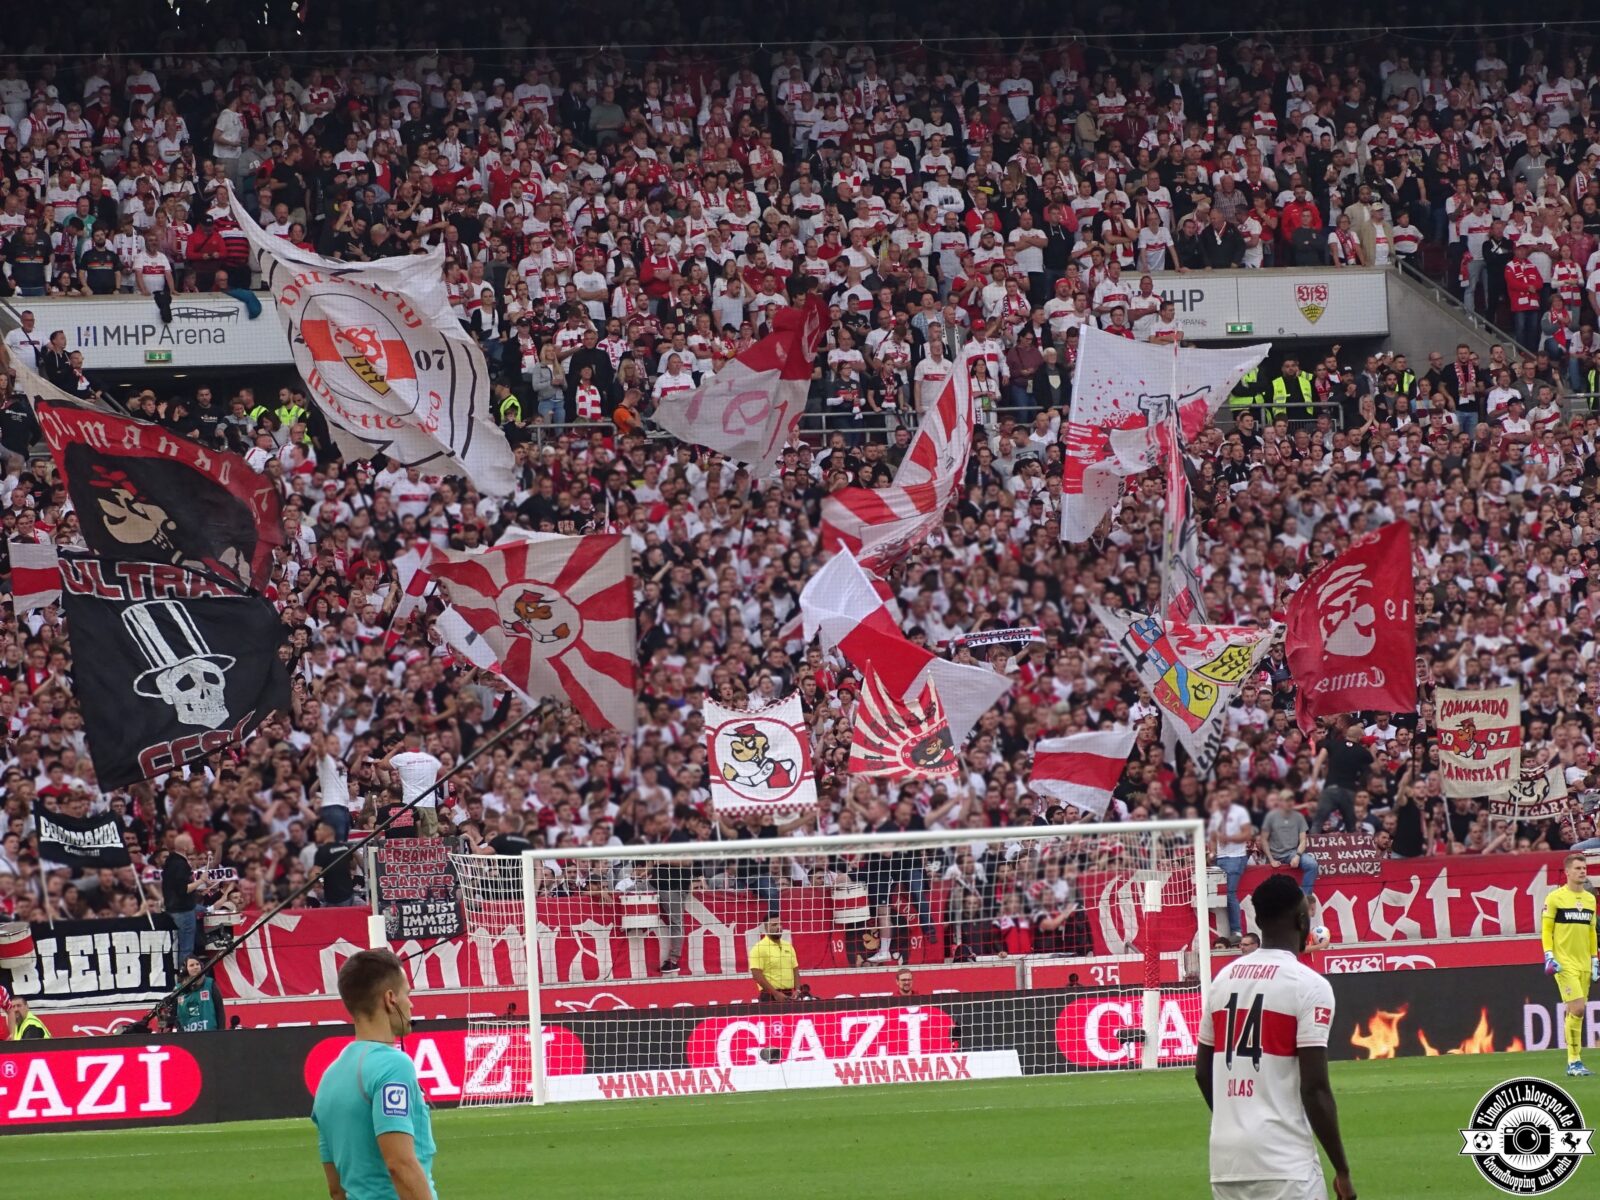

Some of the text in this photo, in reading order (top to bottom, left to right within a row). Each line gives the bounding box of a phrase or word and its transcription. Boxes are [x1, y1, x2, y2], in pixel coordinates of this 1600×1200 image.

[103, 324, 226, 346] MHP Arena
[415, 350, 446, 371] 07
[1440, 698, 1509, 722] COMMANDO
[1441, 731, 1510, 746] 19 97
[40, 815, 122, 844] COMMANDO
[386, 863, 447, 875] KEHRT
[1339, 861, 1381, 875] GANZE
[402, 902, 455, 915] DU BIST
[403, 914, 458, 926] IMMER
[403, 924, 459, 937] BEI UNS!
[832, 936, 924, 953] 19 97
[1090, 965, 1120, 986] 35
[1229, 964, 1280, 980] STUTTGART
[1224, 992, 1265, 1073] 14
[597, 1055, 971, 1098] WINAMAX WINAMAX
[1227, 1079, 1254, 1097] SILAS
